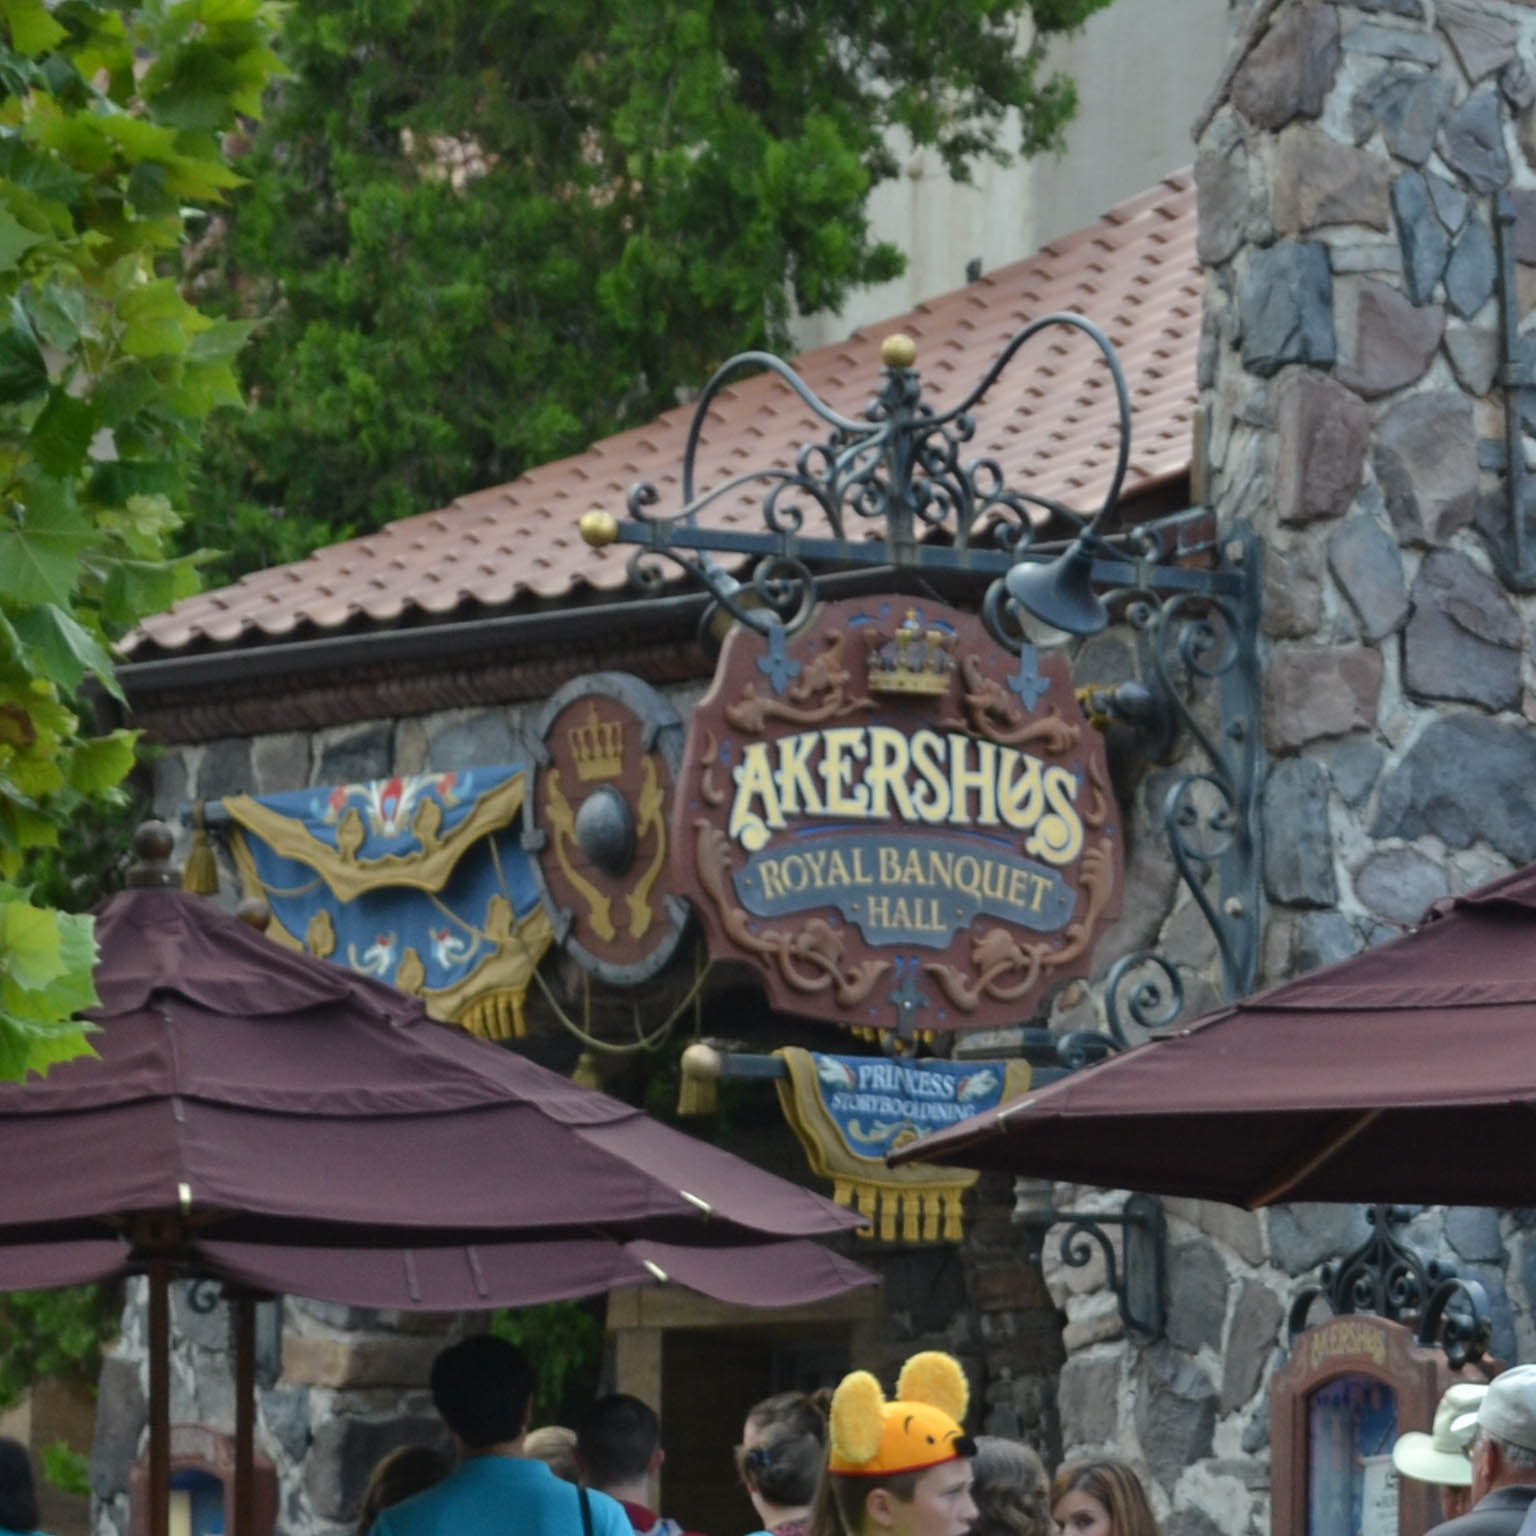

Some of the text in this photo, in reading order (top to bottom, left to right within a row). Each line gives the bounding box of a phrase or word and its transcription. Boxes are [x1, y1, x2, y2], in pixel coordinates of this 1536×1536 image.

[730, 727, 1083, 864] AKERSHUS
[759, 848, 1053, 913] ROYAL BANQUET
[867, 897, 948, 931] HALL
[858, 1064, 955, 1098] PRINCESS
